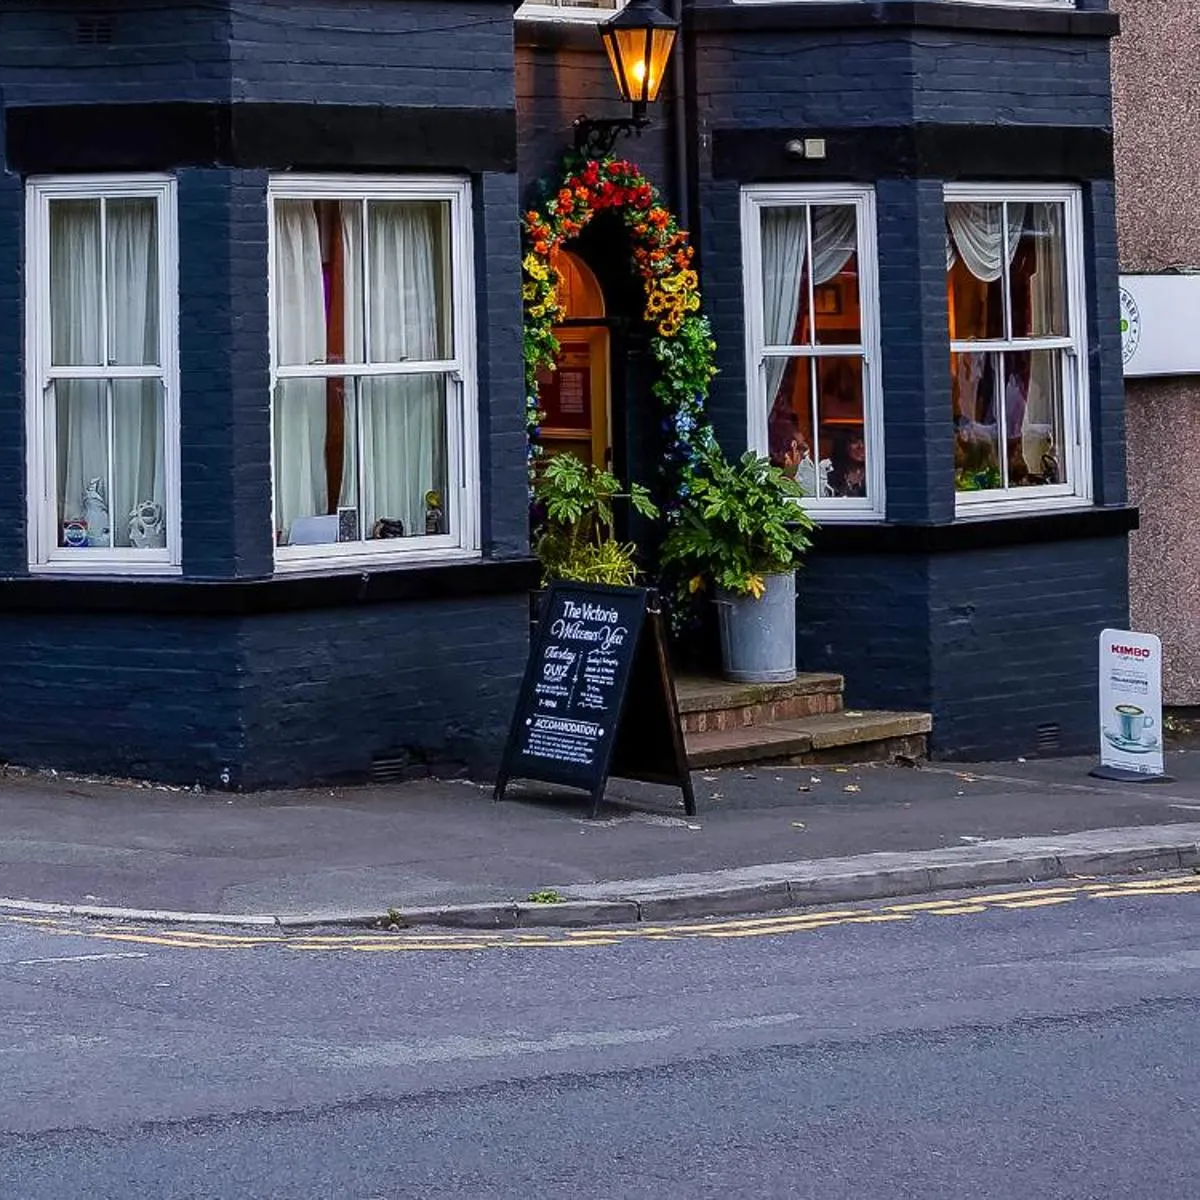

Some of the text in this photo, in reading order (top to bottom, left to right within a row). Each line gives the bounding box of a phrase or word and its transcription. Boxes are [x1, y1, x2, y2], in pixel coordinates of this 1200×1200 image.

[563, 601, 618, 623] The Victoria
[599, 625, 628, 650] You
[544, 646, 576, 664] Tuesday
[1111, 644, 1150, 658] KIMBO
[544, 663, 569, 677] QUIZ
[535, 719, 598, 736] ACCOMMODATION
